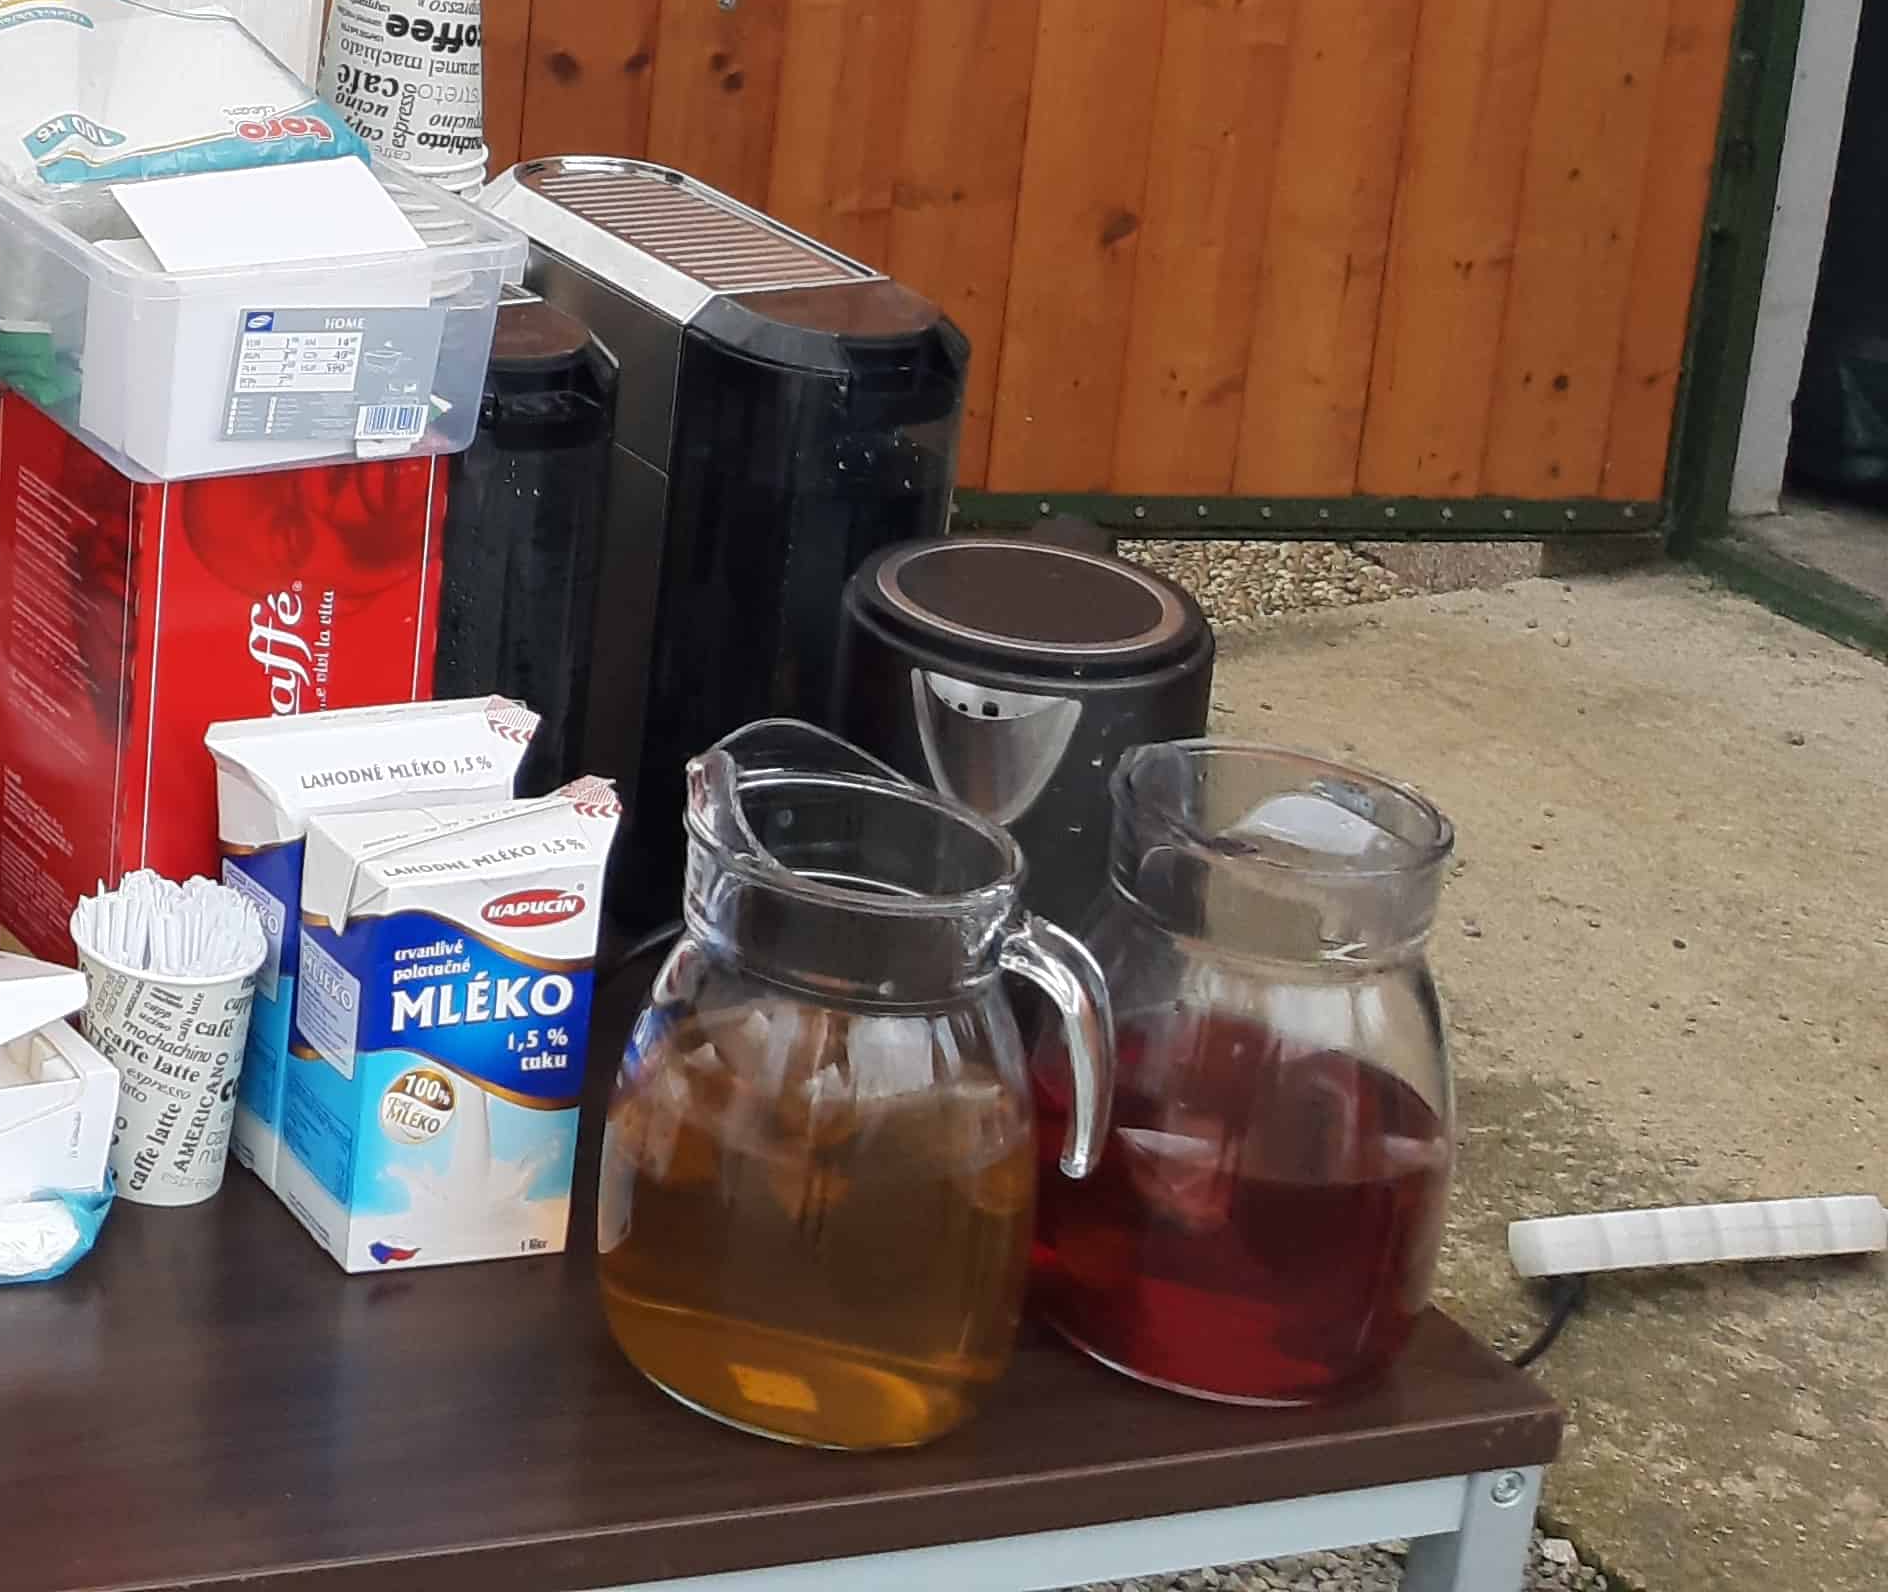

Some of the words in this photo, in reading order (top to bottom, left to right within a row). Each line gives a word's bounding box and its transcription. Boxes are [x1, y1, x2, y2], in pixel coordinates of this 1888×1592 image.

[337, 63, 399, 100] café
[238, 118, 335, 141] toro
[387, 754, 447, 781] MLÉKO
[474, 843, 537, 869] MLÉKO
[391, 970, 575, 1033] MLÉKO
[103, 1025, 150, 1065] caffe
[153, 1055, 201, 1084] latte
[122, 1019, 212, 1064] mochachino
[505, 1029, 540, 1054] 1,5
[546, 1027, 569, 1048] %
[520, 1052, 569, 1072] tuku
[173, 1051, 230, 1174] AMERICANO
[128, 1146, 160, 1192] caffe
[145, 1102, 183, 1148] latte
